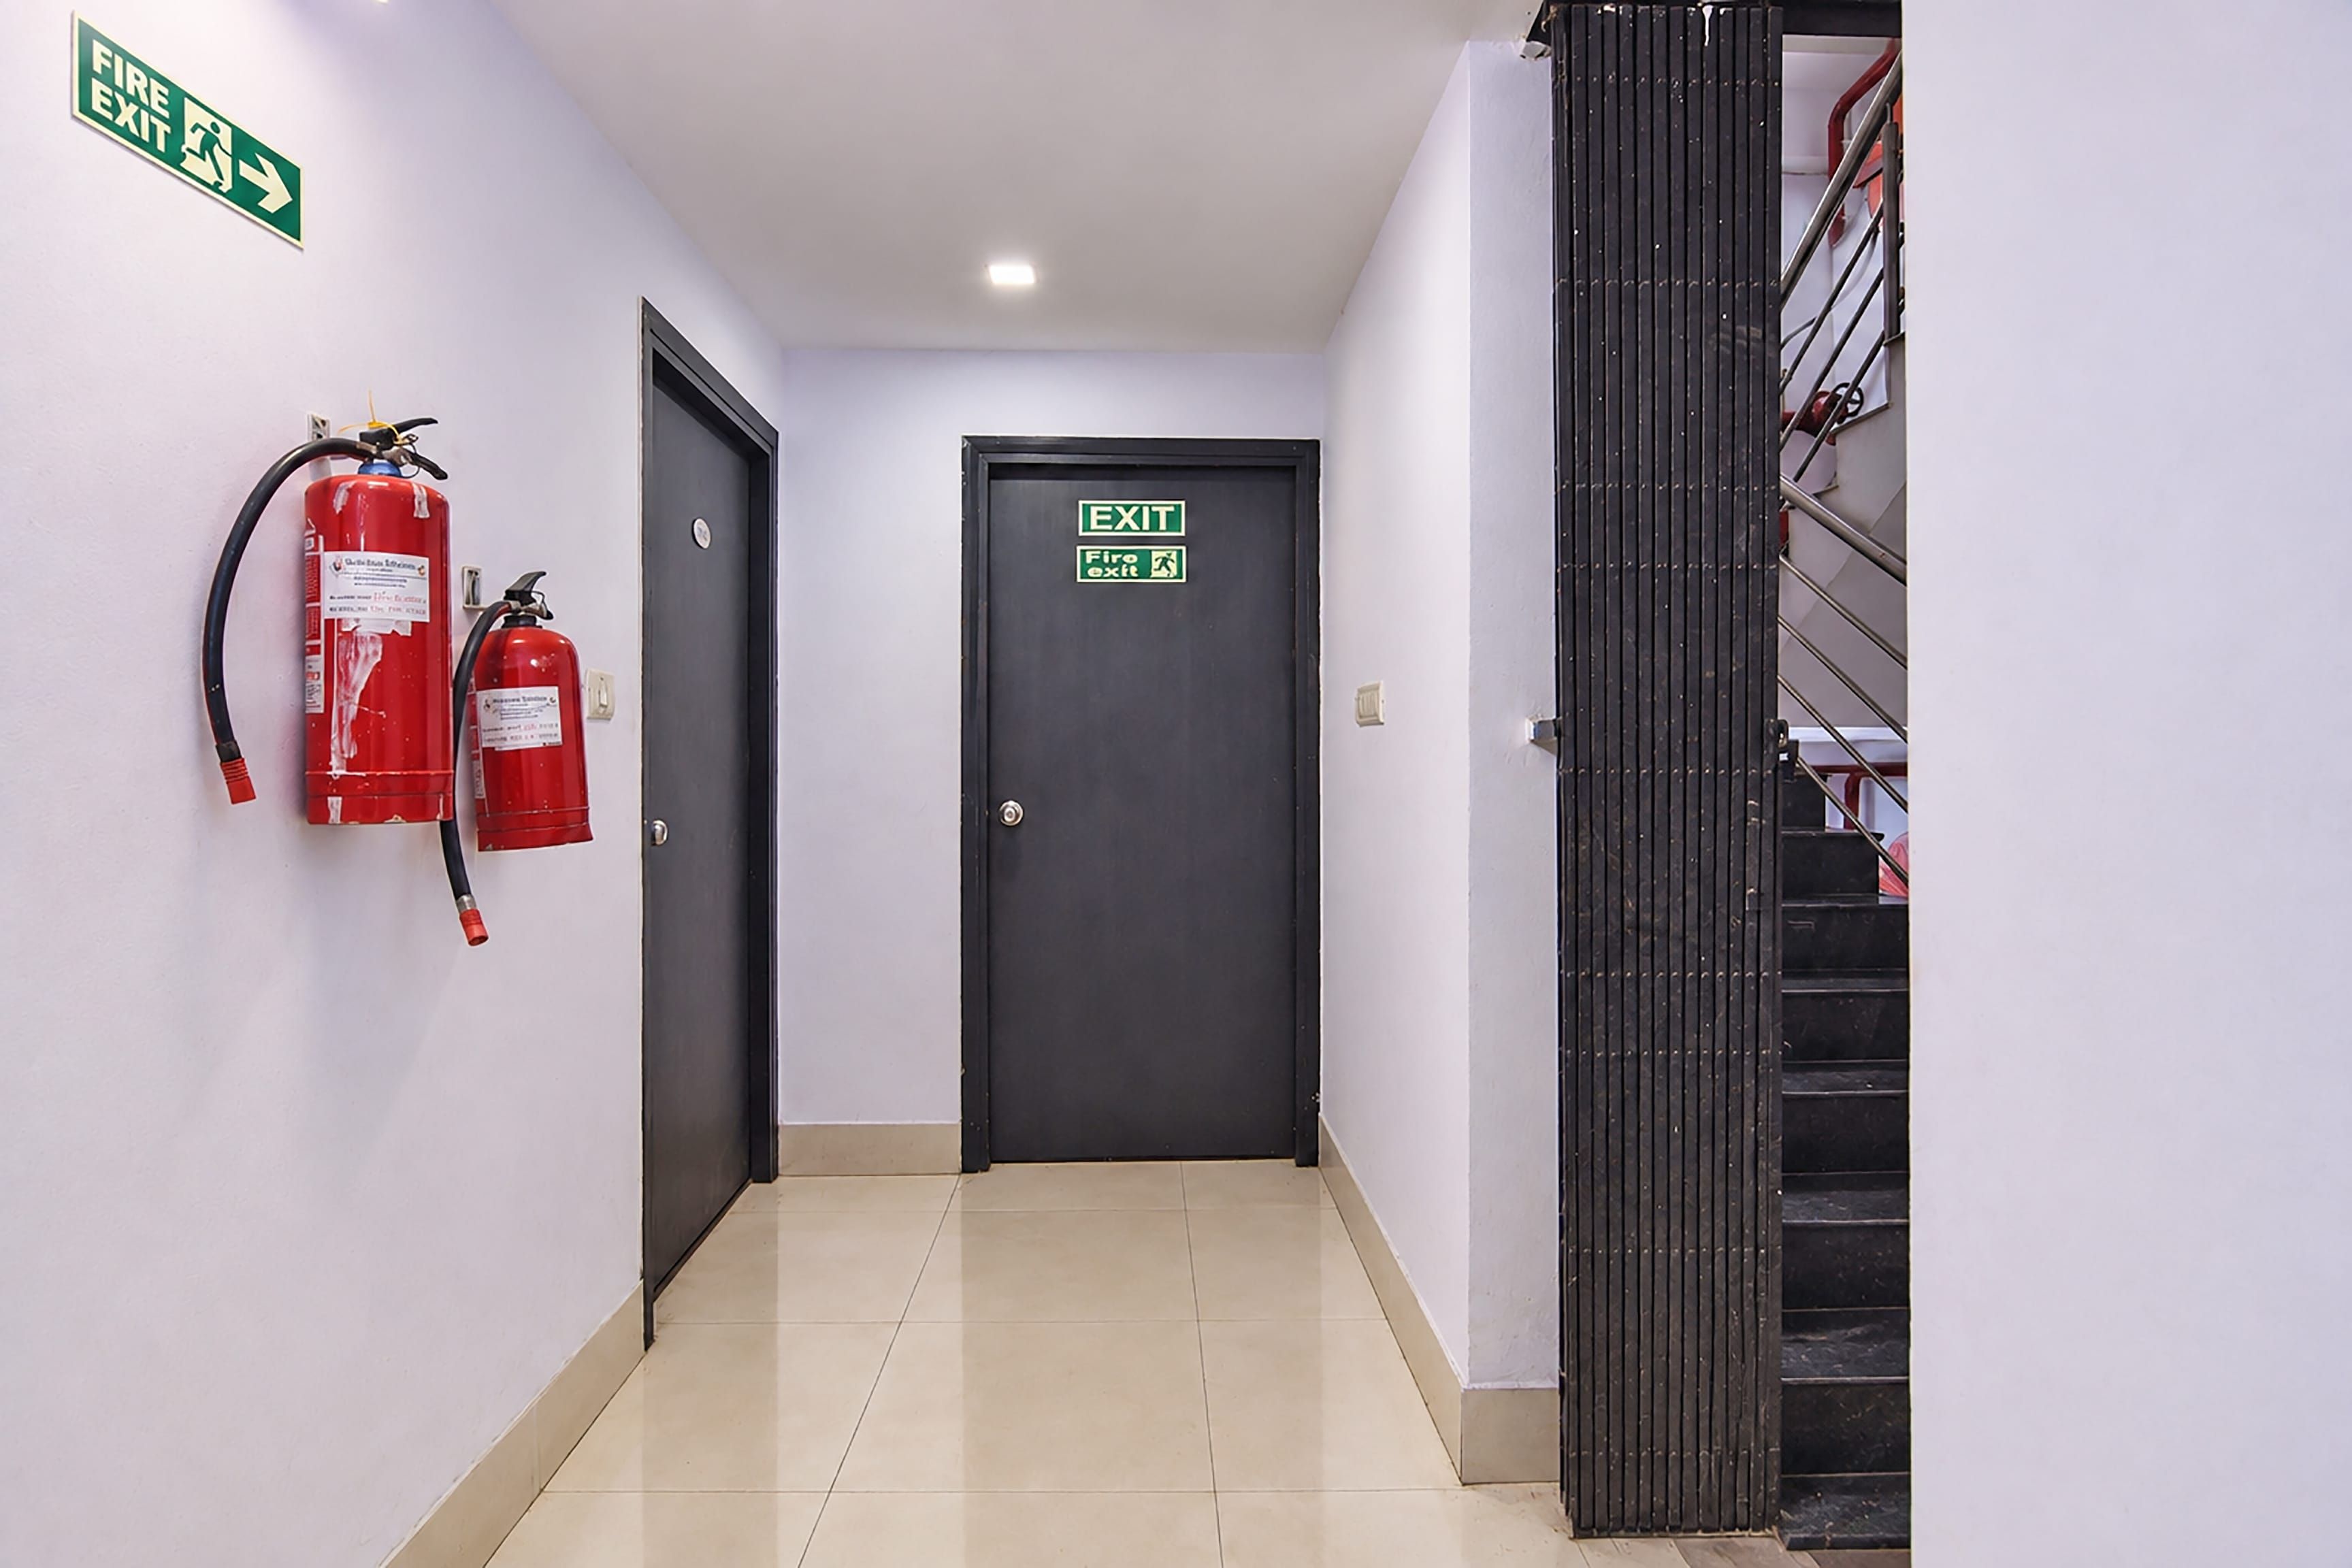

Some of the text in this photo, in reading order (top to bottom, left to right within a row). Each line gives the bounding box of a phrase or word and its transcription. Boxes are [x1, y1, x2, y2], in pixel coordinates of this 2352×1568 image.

[93, 39, 169, 119] FIRE
[91, 77, 171, 153] EXIT
[1090, 506, 1175, 530] EXIT
[1085, 551, 1138, 564] Fire
[1087, 564, 1139, 577] exit
